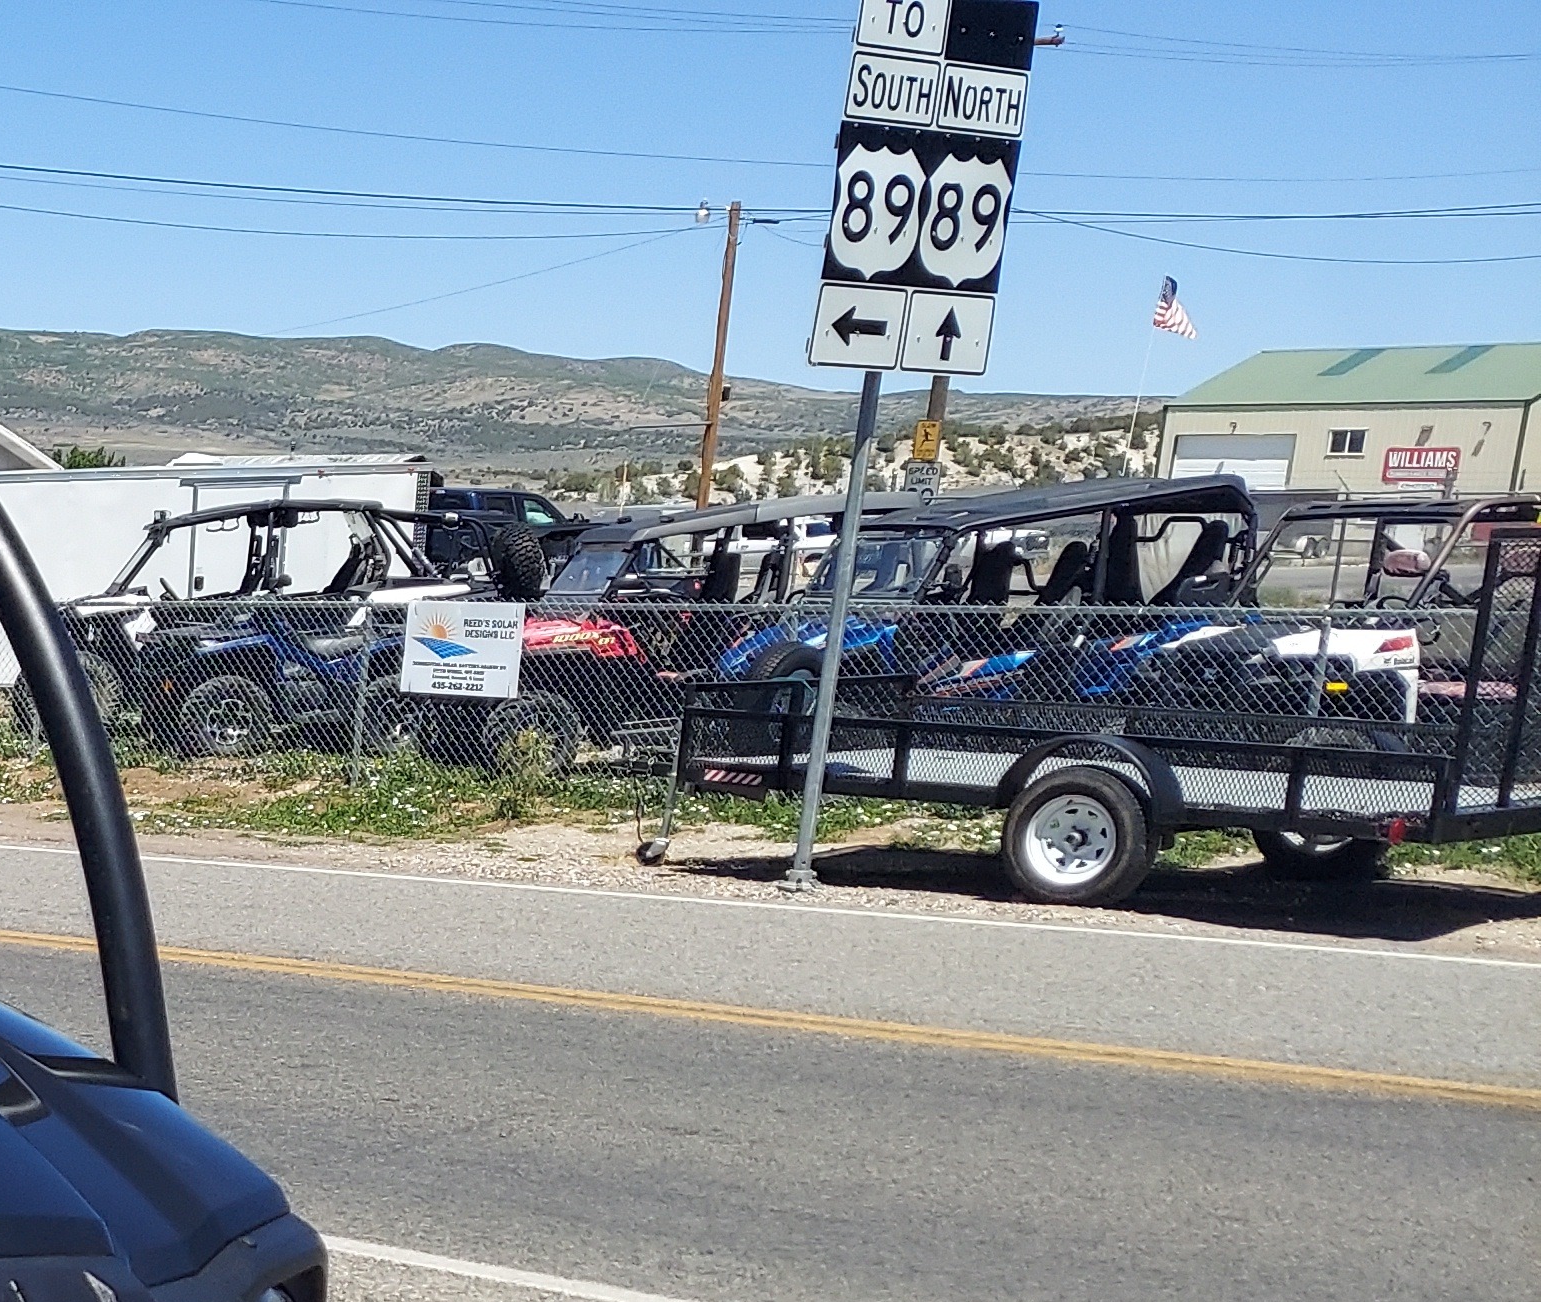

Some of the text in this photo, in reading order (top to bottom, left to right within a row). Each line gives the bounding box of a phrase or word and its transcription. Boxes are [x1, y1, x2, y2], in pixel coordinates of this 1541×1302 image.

[886, 0, 925, 38] TO
[852, 63, 934, 116] SOUTH
[942, 75, 1023, 127] NORTH
[841, 169, 916, 246] 89
[930, 182, 1002, 254] 89
[1388, 451, 1457, 468] WILLIAMS
[499, 630, 515, 640] LLC
